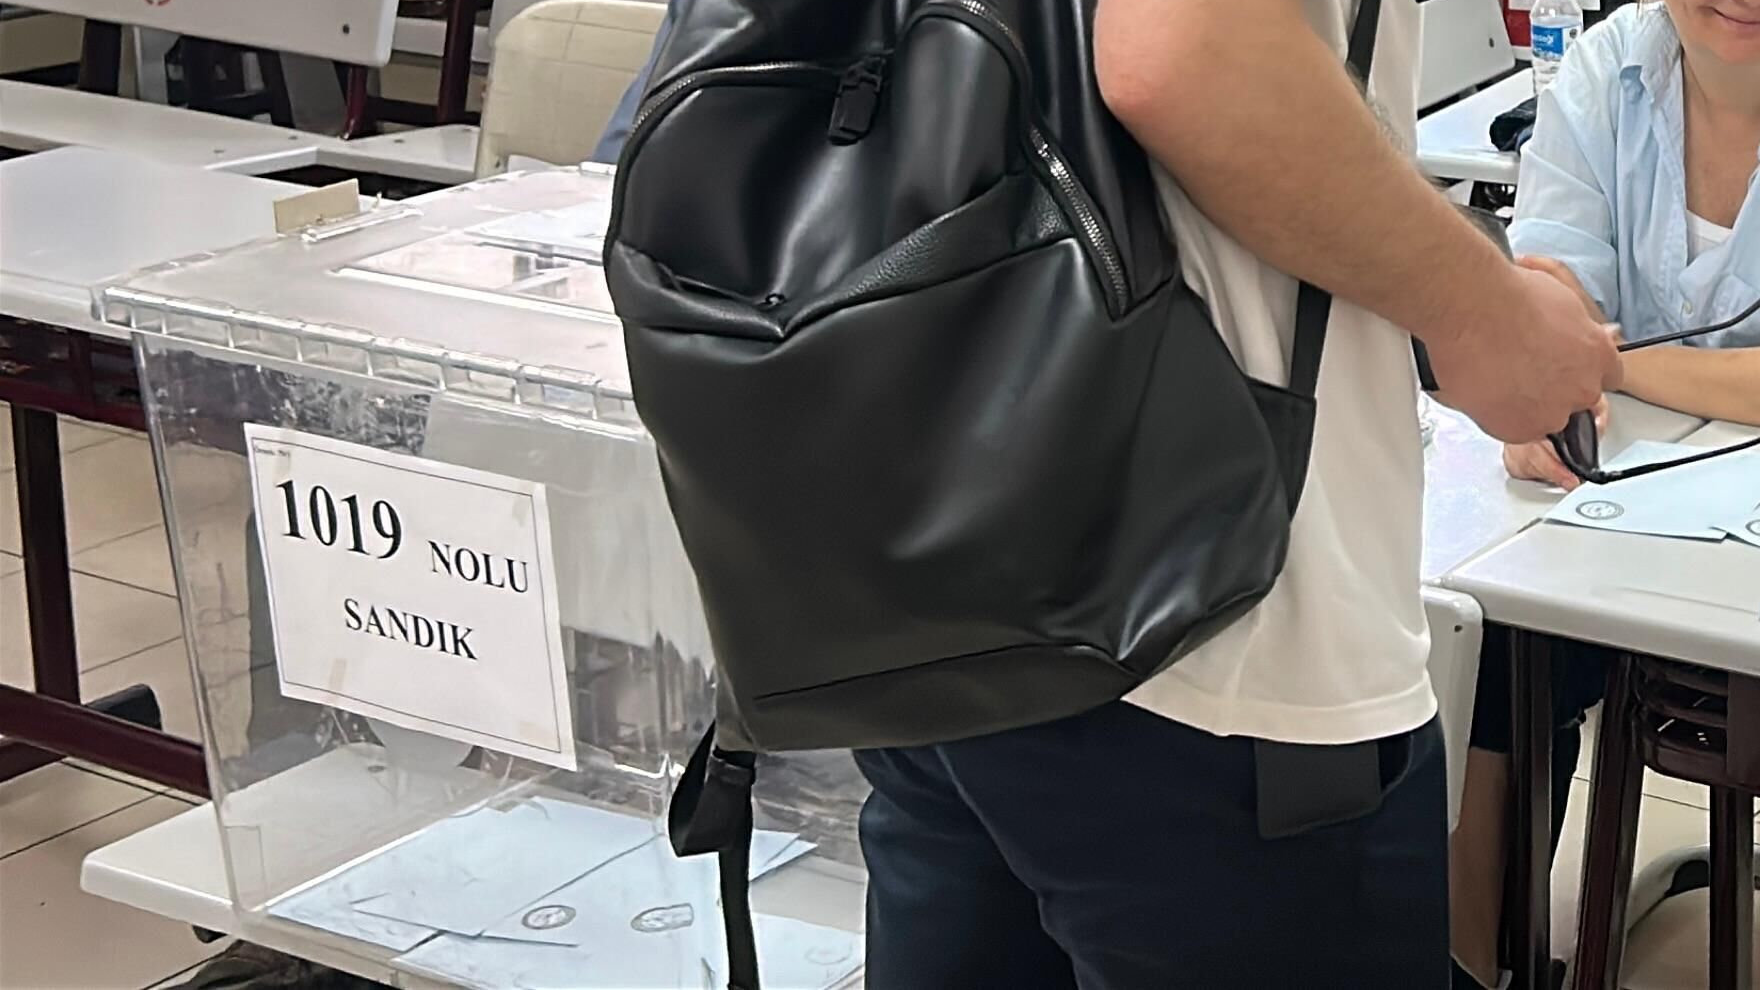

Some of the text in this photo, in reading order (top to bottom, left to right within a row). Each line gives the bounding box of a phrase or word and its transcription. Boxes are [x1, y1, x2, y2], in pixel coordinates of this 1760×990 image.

[276, 479, 530, 594] 1019 NOLU
[343, 597, 479, 661] SANDIK
